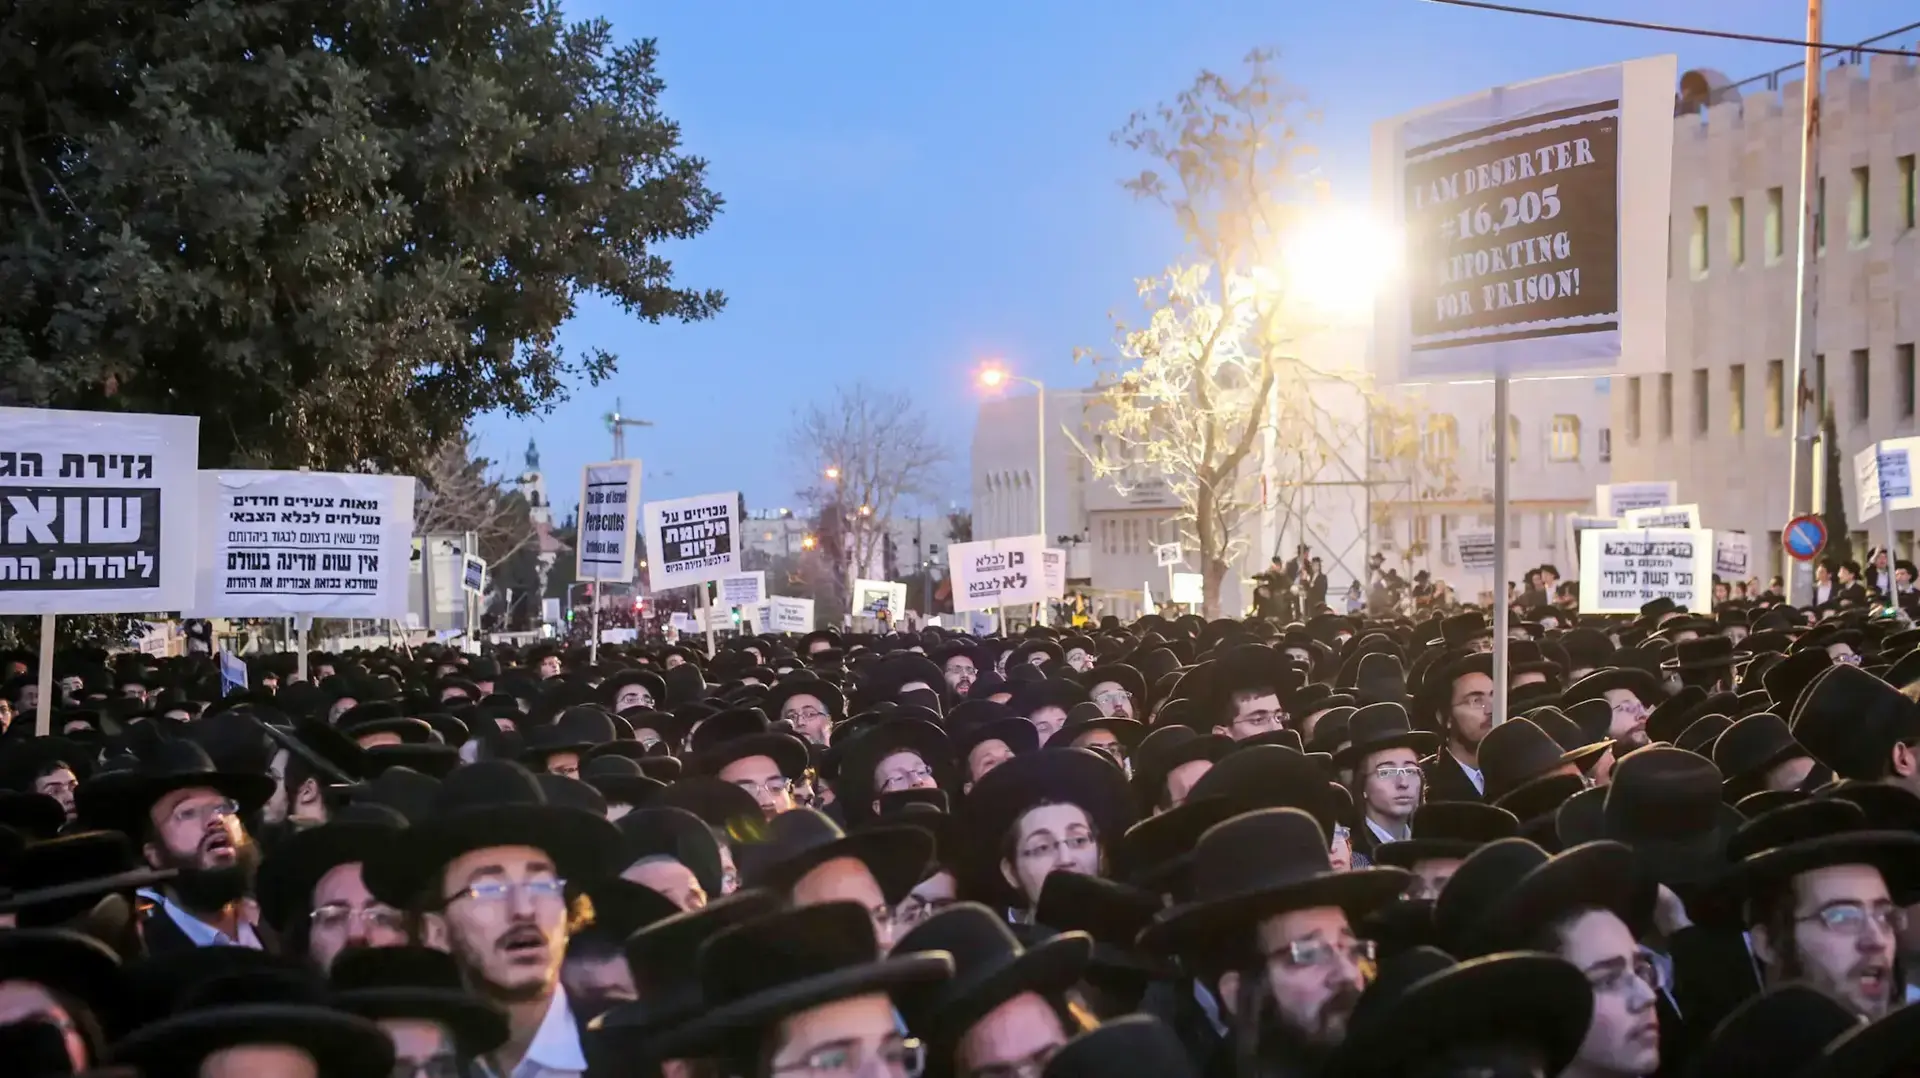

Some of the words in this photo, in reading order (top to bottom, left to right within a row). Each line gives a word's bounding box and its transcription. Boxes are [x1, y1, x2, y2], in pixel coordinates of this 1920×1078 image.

[1414, 186, 1424, 209] I
[1430, 172, 1459, 202] AM
[1464, 138, 1595, 195] DESERTER
[1435, 290, 1473, 321] FOR
[1482, 268, 1580, 312] PRISON!
[59, 453, 152, 478] גזירת
[233, 496, 278, 507] חרדים
[284, 496, 334, 508] צעירים
[339, 498, 378, 510] מאות
[0, 496, 142, 543] שוא
[229, 511, 276, 523] הצבאי
[281, 511, 320, 524] לכלא
[325, 512, 381, 526] נשלחים
[662, 510, 679, 523] על
[684, 505, 727, 521] מכריזים
[585, 511, 625, 531] Persecutes
[228, 531, 268, 543] ביהדותם
[271, 530, 296, 543] לבגוד
[300, 532, 331, 543] ברצונם
[334, 532, 356, 545] שאין
[358, 533, 380, 545] מפני
[665, 520, 727, 544] מלחמת
[680, 538, 716, 557] קיום
[53, 550, 153, 580] ליהדות
[227, 551, 270, 571] בעולם
[277, 553, 316, 571] מדינה
[322, 554, 351, 571] שום
[357, 555, 379, 574] אין
[976, 553, 1005, 566] לכלא
[1008, 551, 1024, 568] כן
[226, 577, 256, 588] היהדות
[260, 577, 273, 588] את
[969, 578, 1000, 591] לצבא
[1003, 573, 1027, 588] לא
[1604, 570, 1637, 585] ליהודי
[1642, 571, 1669, 586] קשה
[1675, 572, 1693, 585] הכי
[1639, 590, 1653, 599] על
